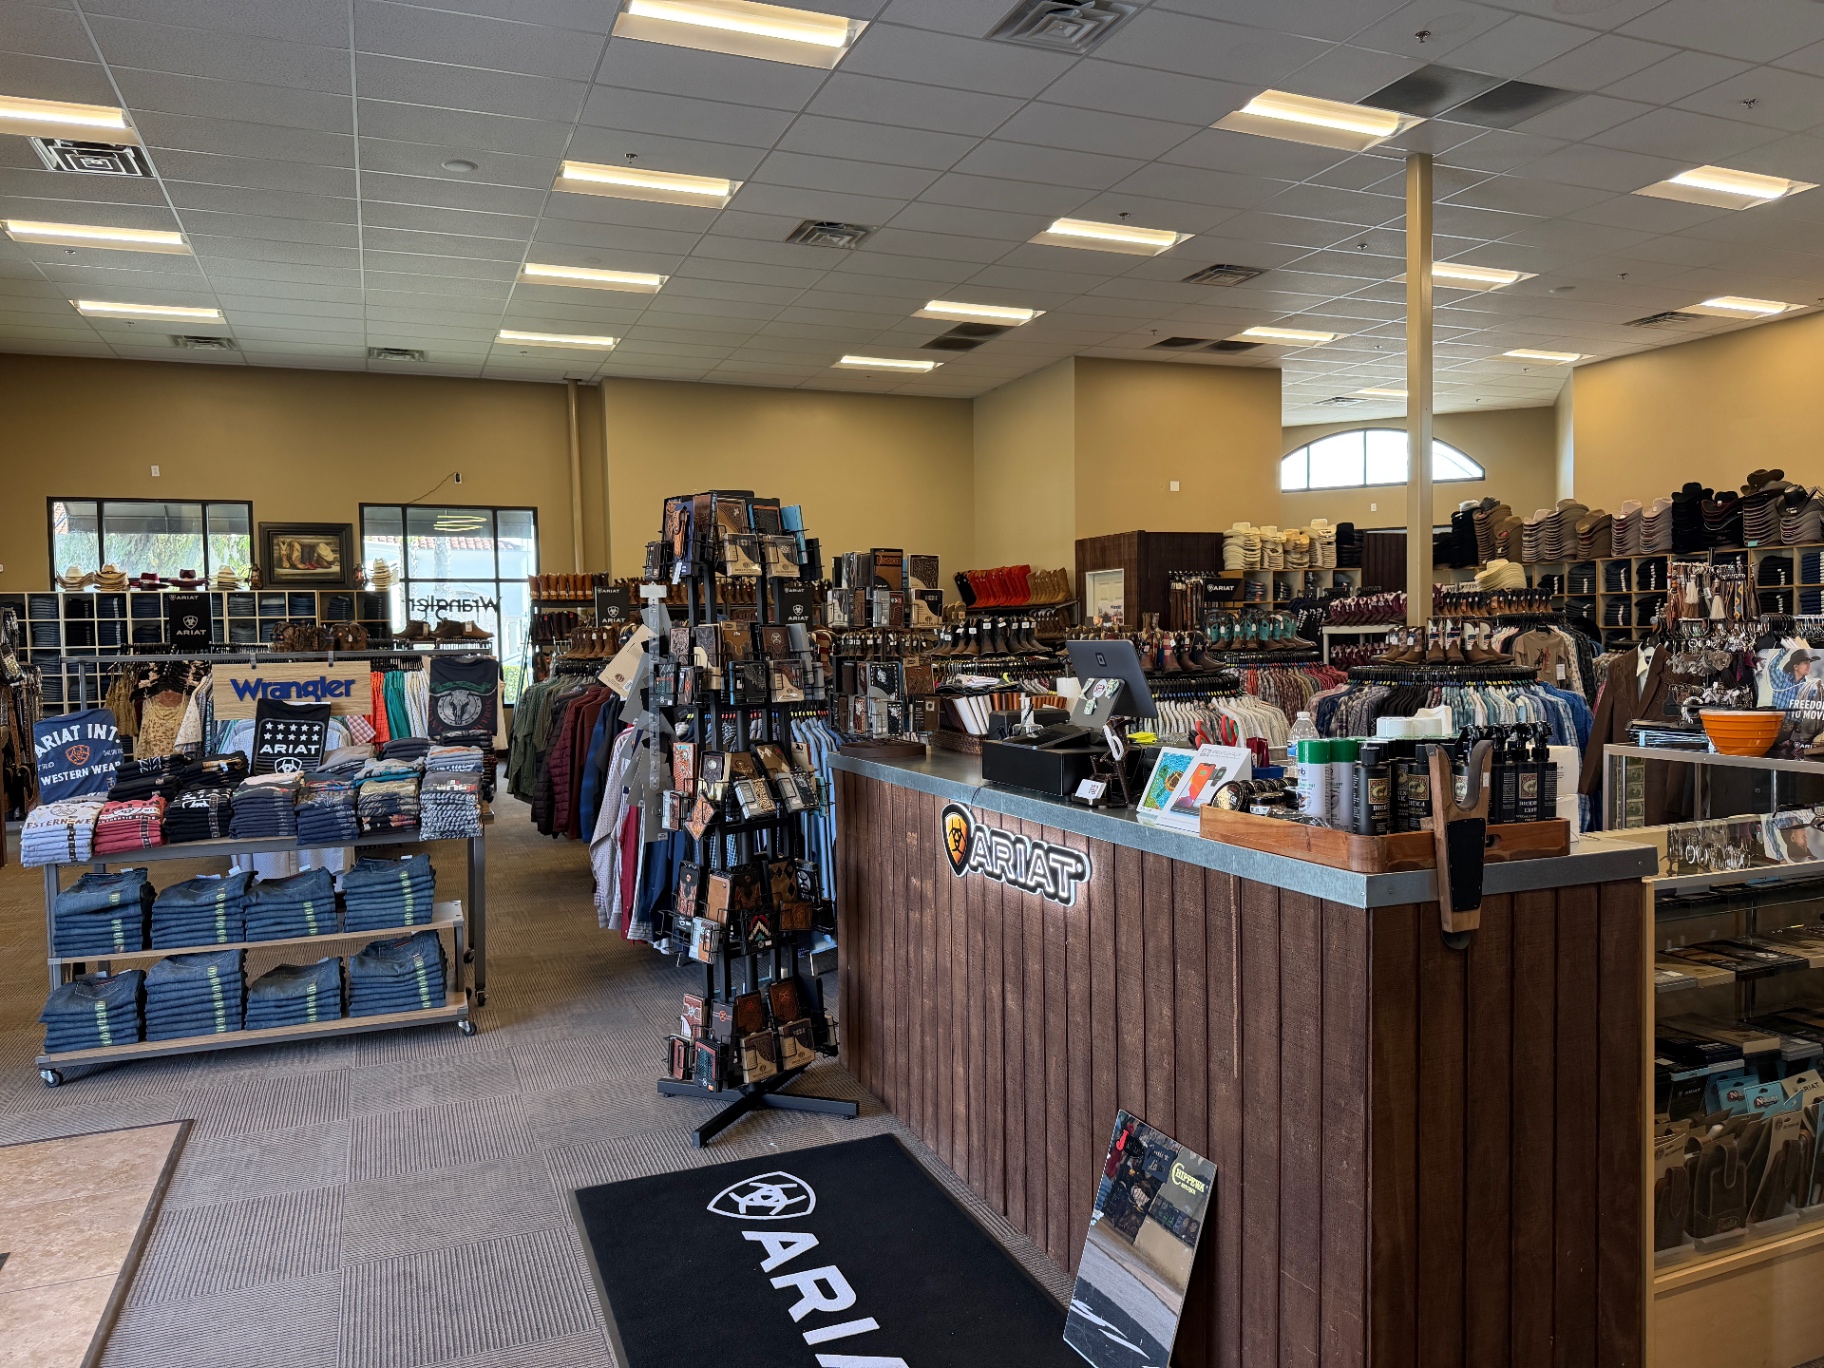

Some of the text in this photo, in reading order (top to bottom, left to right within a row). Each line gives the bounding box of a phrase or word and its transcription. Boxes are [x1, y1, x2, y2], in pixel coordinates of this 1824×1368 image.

[229, 676, 356, 702] Wrangler
[1789, 699, 1824, 710] FREEDO
[35, 723, 121, 758] ARIAT INT.
[260, 744, 320, 755] ARIAT
[40, 767, 89, 786] WESTERN
[27, 817, 95, 830] ESTERN WE
[968, 829, 1083, 900] ARIAT
[1802, 1081, 1819, 1093] RIAT
[1171, 1162, 1206, 1193] CHIPPEWA
[741, 1230, 910, 1368] ARI
